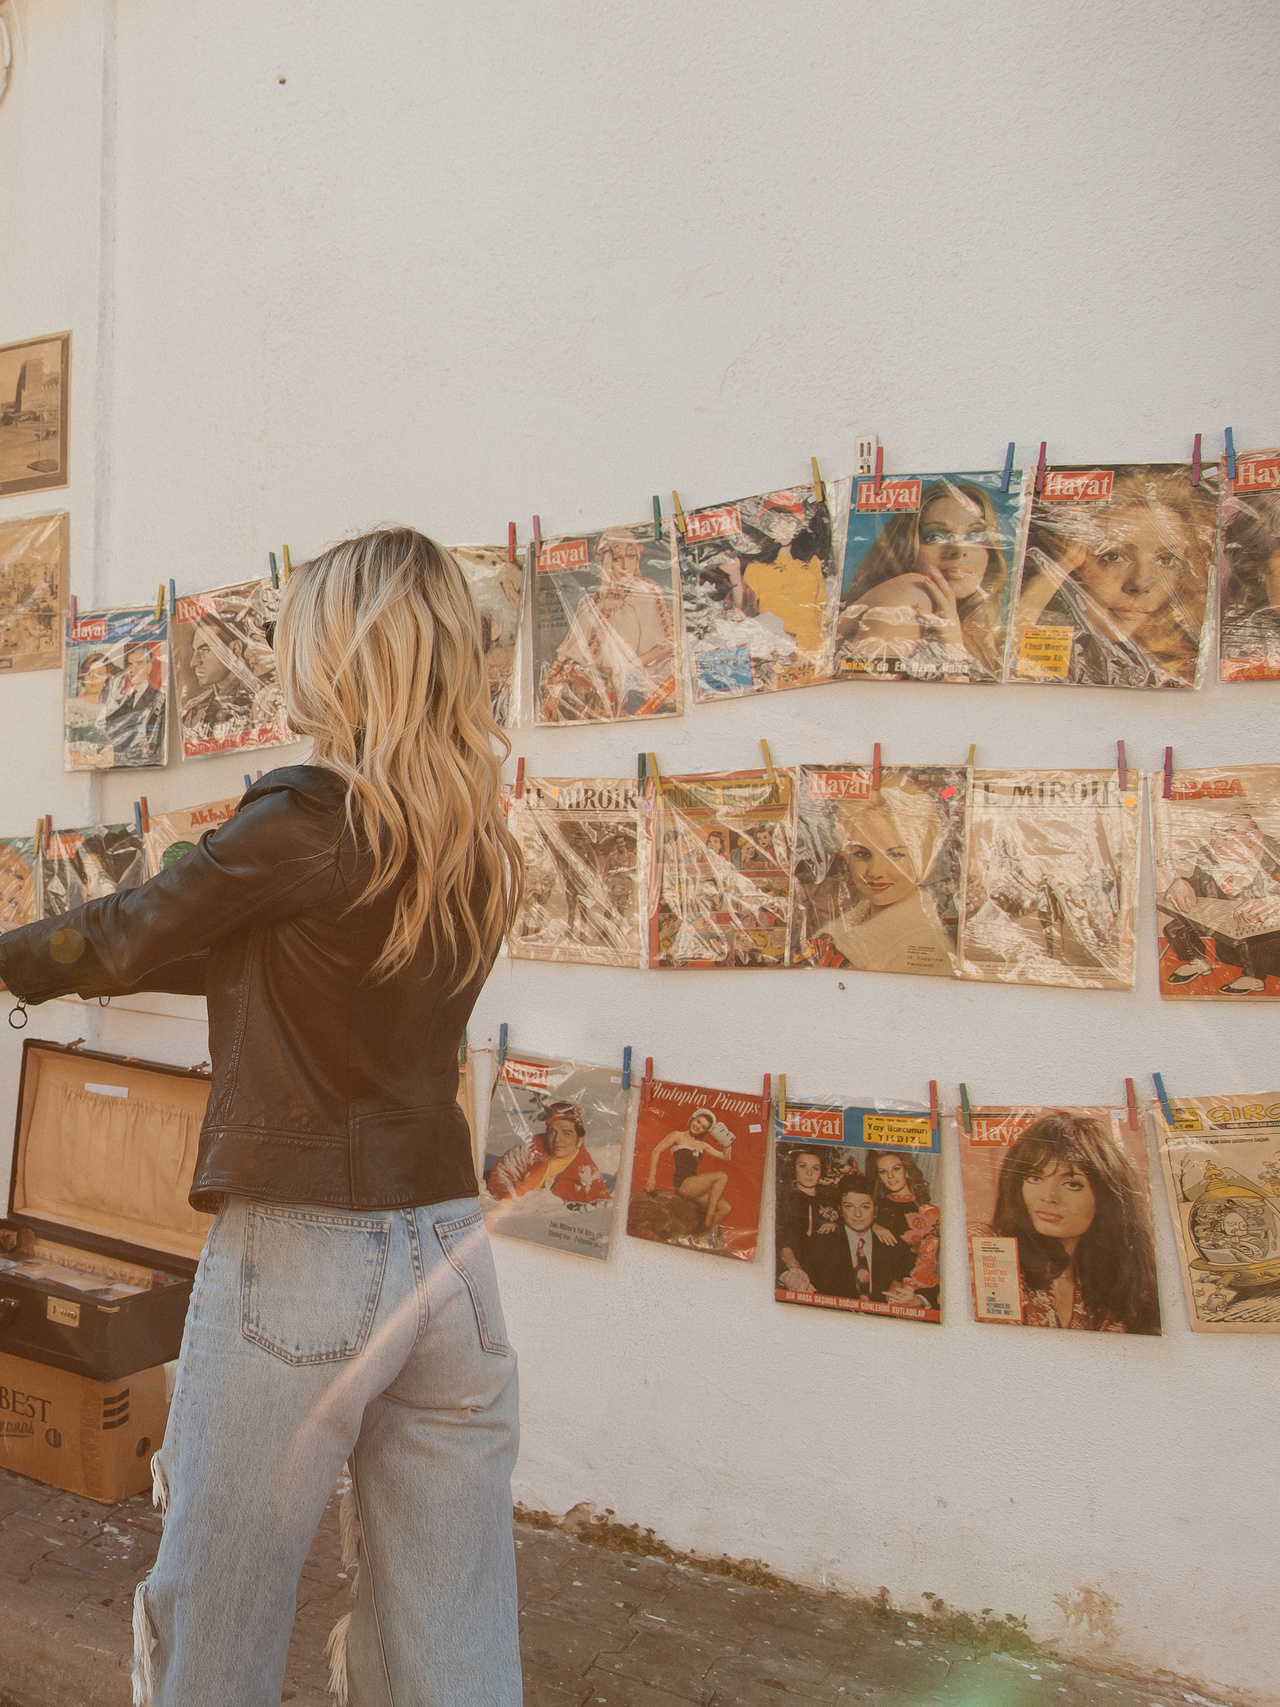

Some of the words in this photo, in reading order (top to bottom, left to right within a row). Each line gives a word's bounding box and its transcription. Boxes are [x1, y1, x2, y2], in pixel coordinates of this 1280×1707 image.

[859, 483, 919, 508] Hayat
[1044, 474, 1110, 501] Hayat
[686, 510, 739, 537] Hayat
[538, 543, 586, 568] Hayat
[812, 773, 867, 798] Hayat
[1011, 780, 1123, 806] MIROIR
[556, 788, 638, 810] MIROIR
[711, 1092, 761, 1118] Pinups
[785, 1111, 841, 1138] Hayat
[867, 1122, 884, 1133] Yay
[786, 1291, 796, 1300] BİR
[797, 1293, 813, 1303] MASA
[814, 1295, 838, 1306] BAŞINDA
[838, 1299, 860, 1309] DOĞUM
[860, 1301, 891, 1314] GÜNLERİNİ
[891, 1306, 927, 1318] KUTLADILAR
